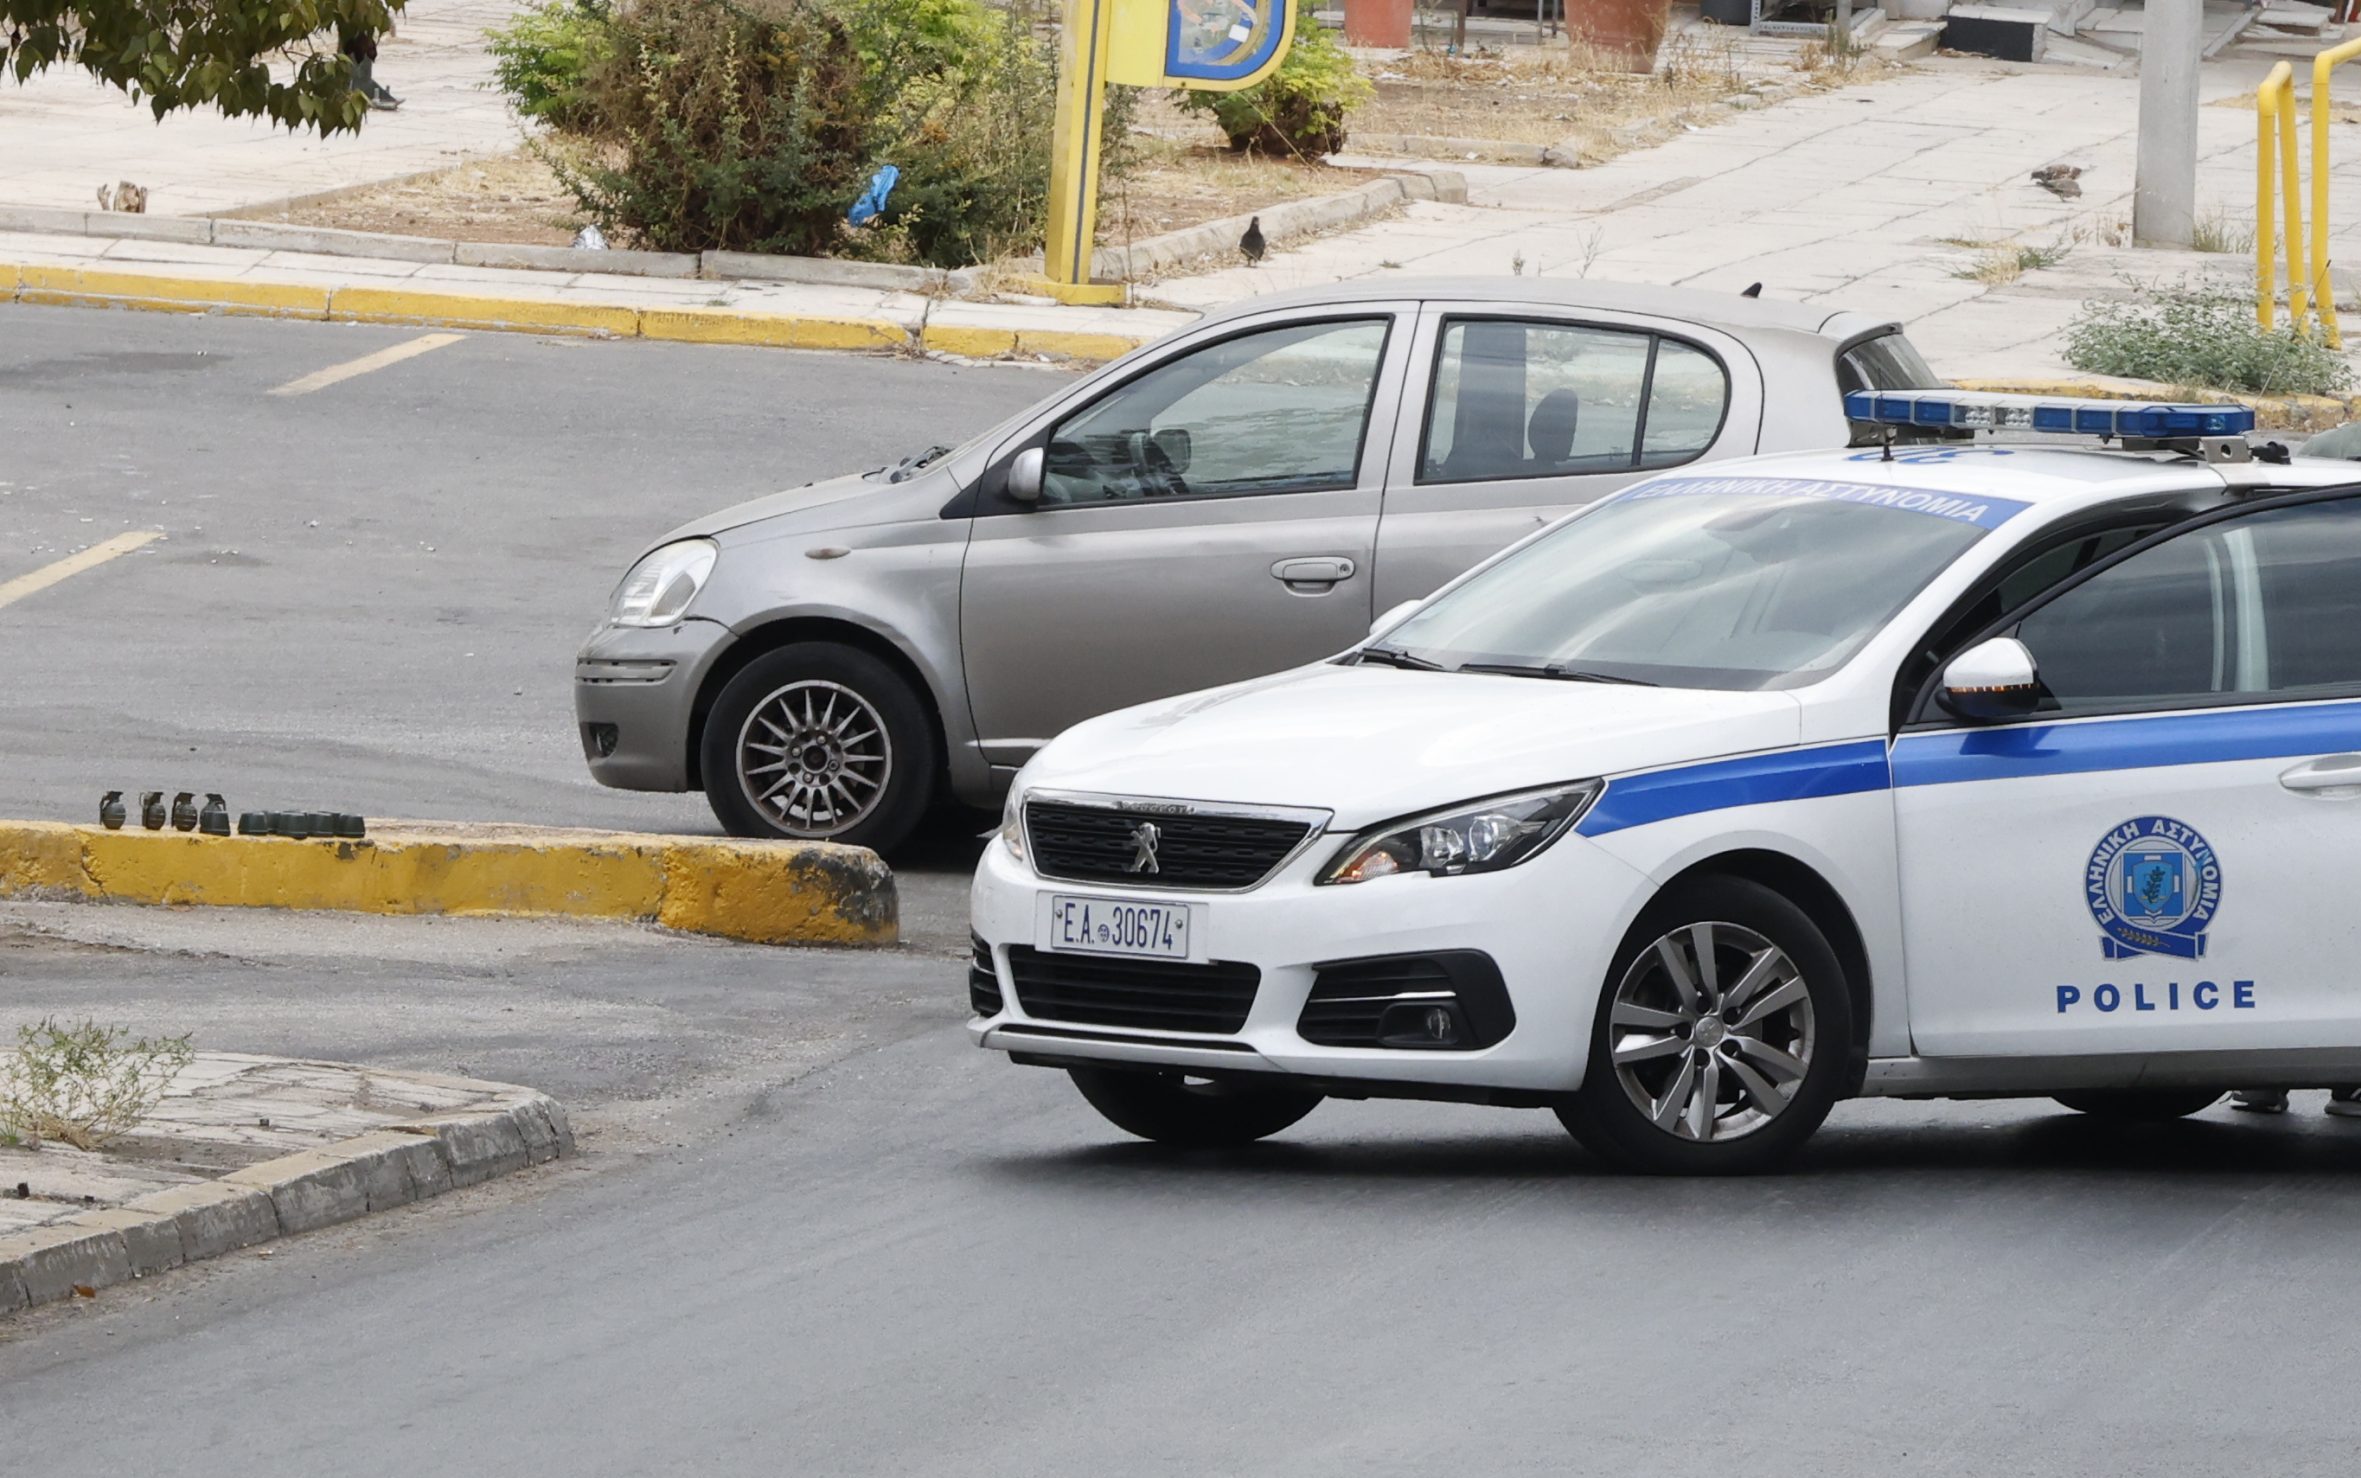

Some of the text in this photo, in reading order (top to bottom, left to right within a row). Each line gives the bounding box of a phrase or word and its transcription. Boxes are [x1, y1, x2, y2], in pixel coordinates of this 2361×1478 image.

[1802, 483, 1989, 522] ΑΣΤΥΝΟΜΙΑ
[2089, 819, 2219, 925] ΕΛΛΗΝΙΚΗ ΑΣΤΥΝΟΜΙΑ
[1112, 906, 1173, 950] 30674
[2056, 980, 2255, 1013] POLICE
